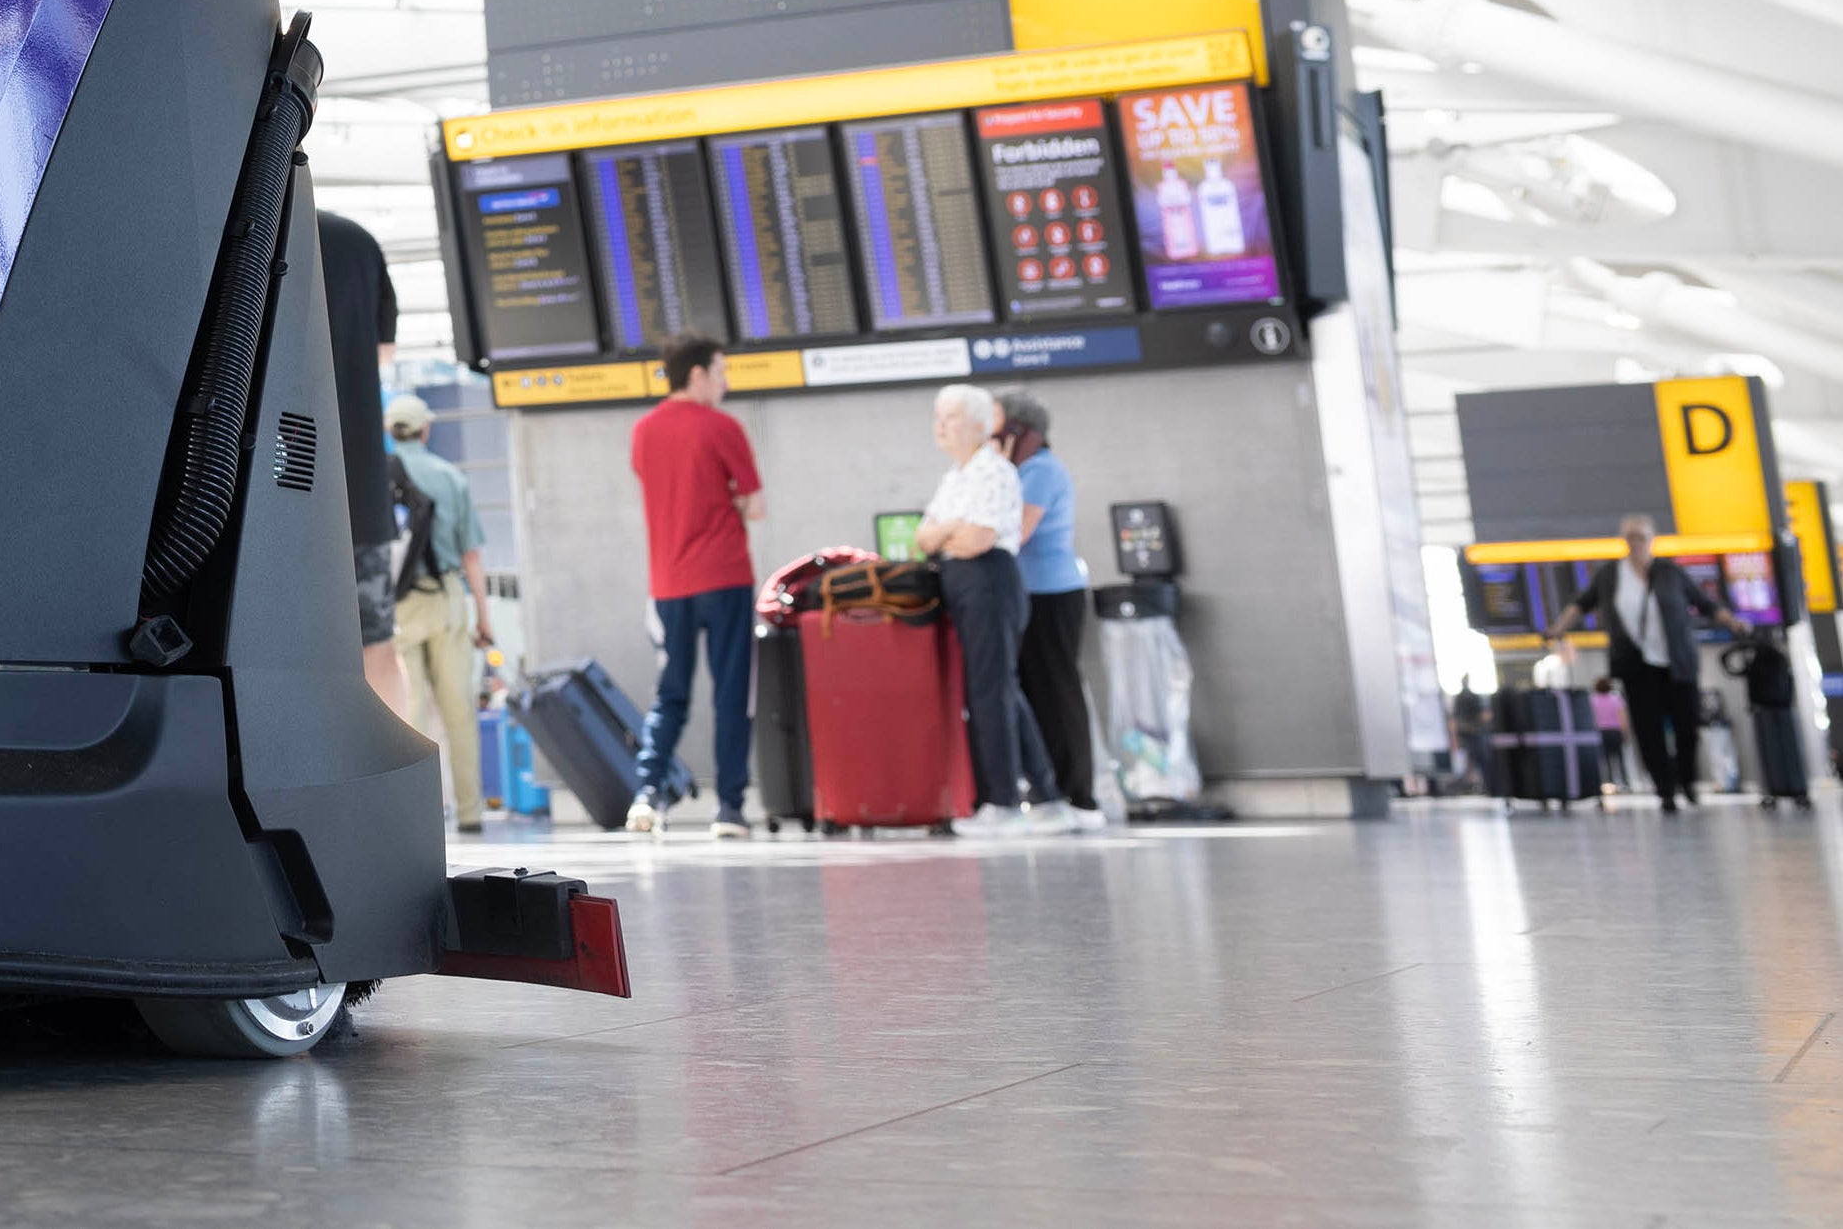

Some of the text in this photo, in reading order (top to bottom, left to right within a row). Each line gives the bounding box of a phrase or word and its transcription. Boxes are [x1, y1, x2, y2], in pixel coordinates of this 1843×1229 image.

[1132, 89, 1238, 131] SAVE
[991, 135, 1101, 165] Forbidden
[1680, 403, 1734, 456] D
